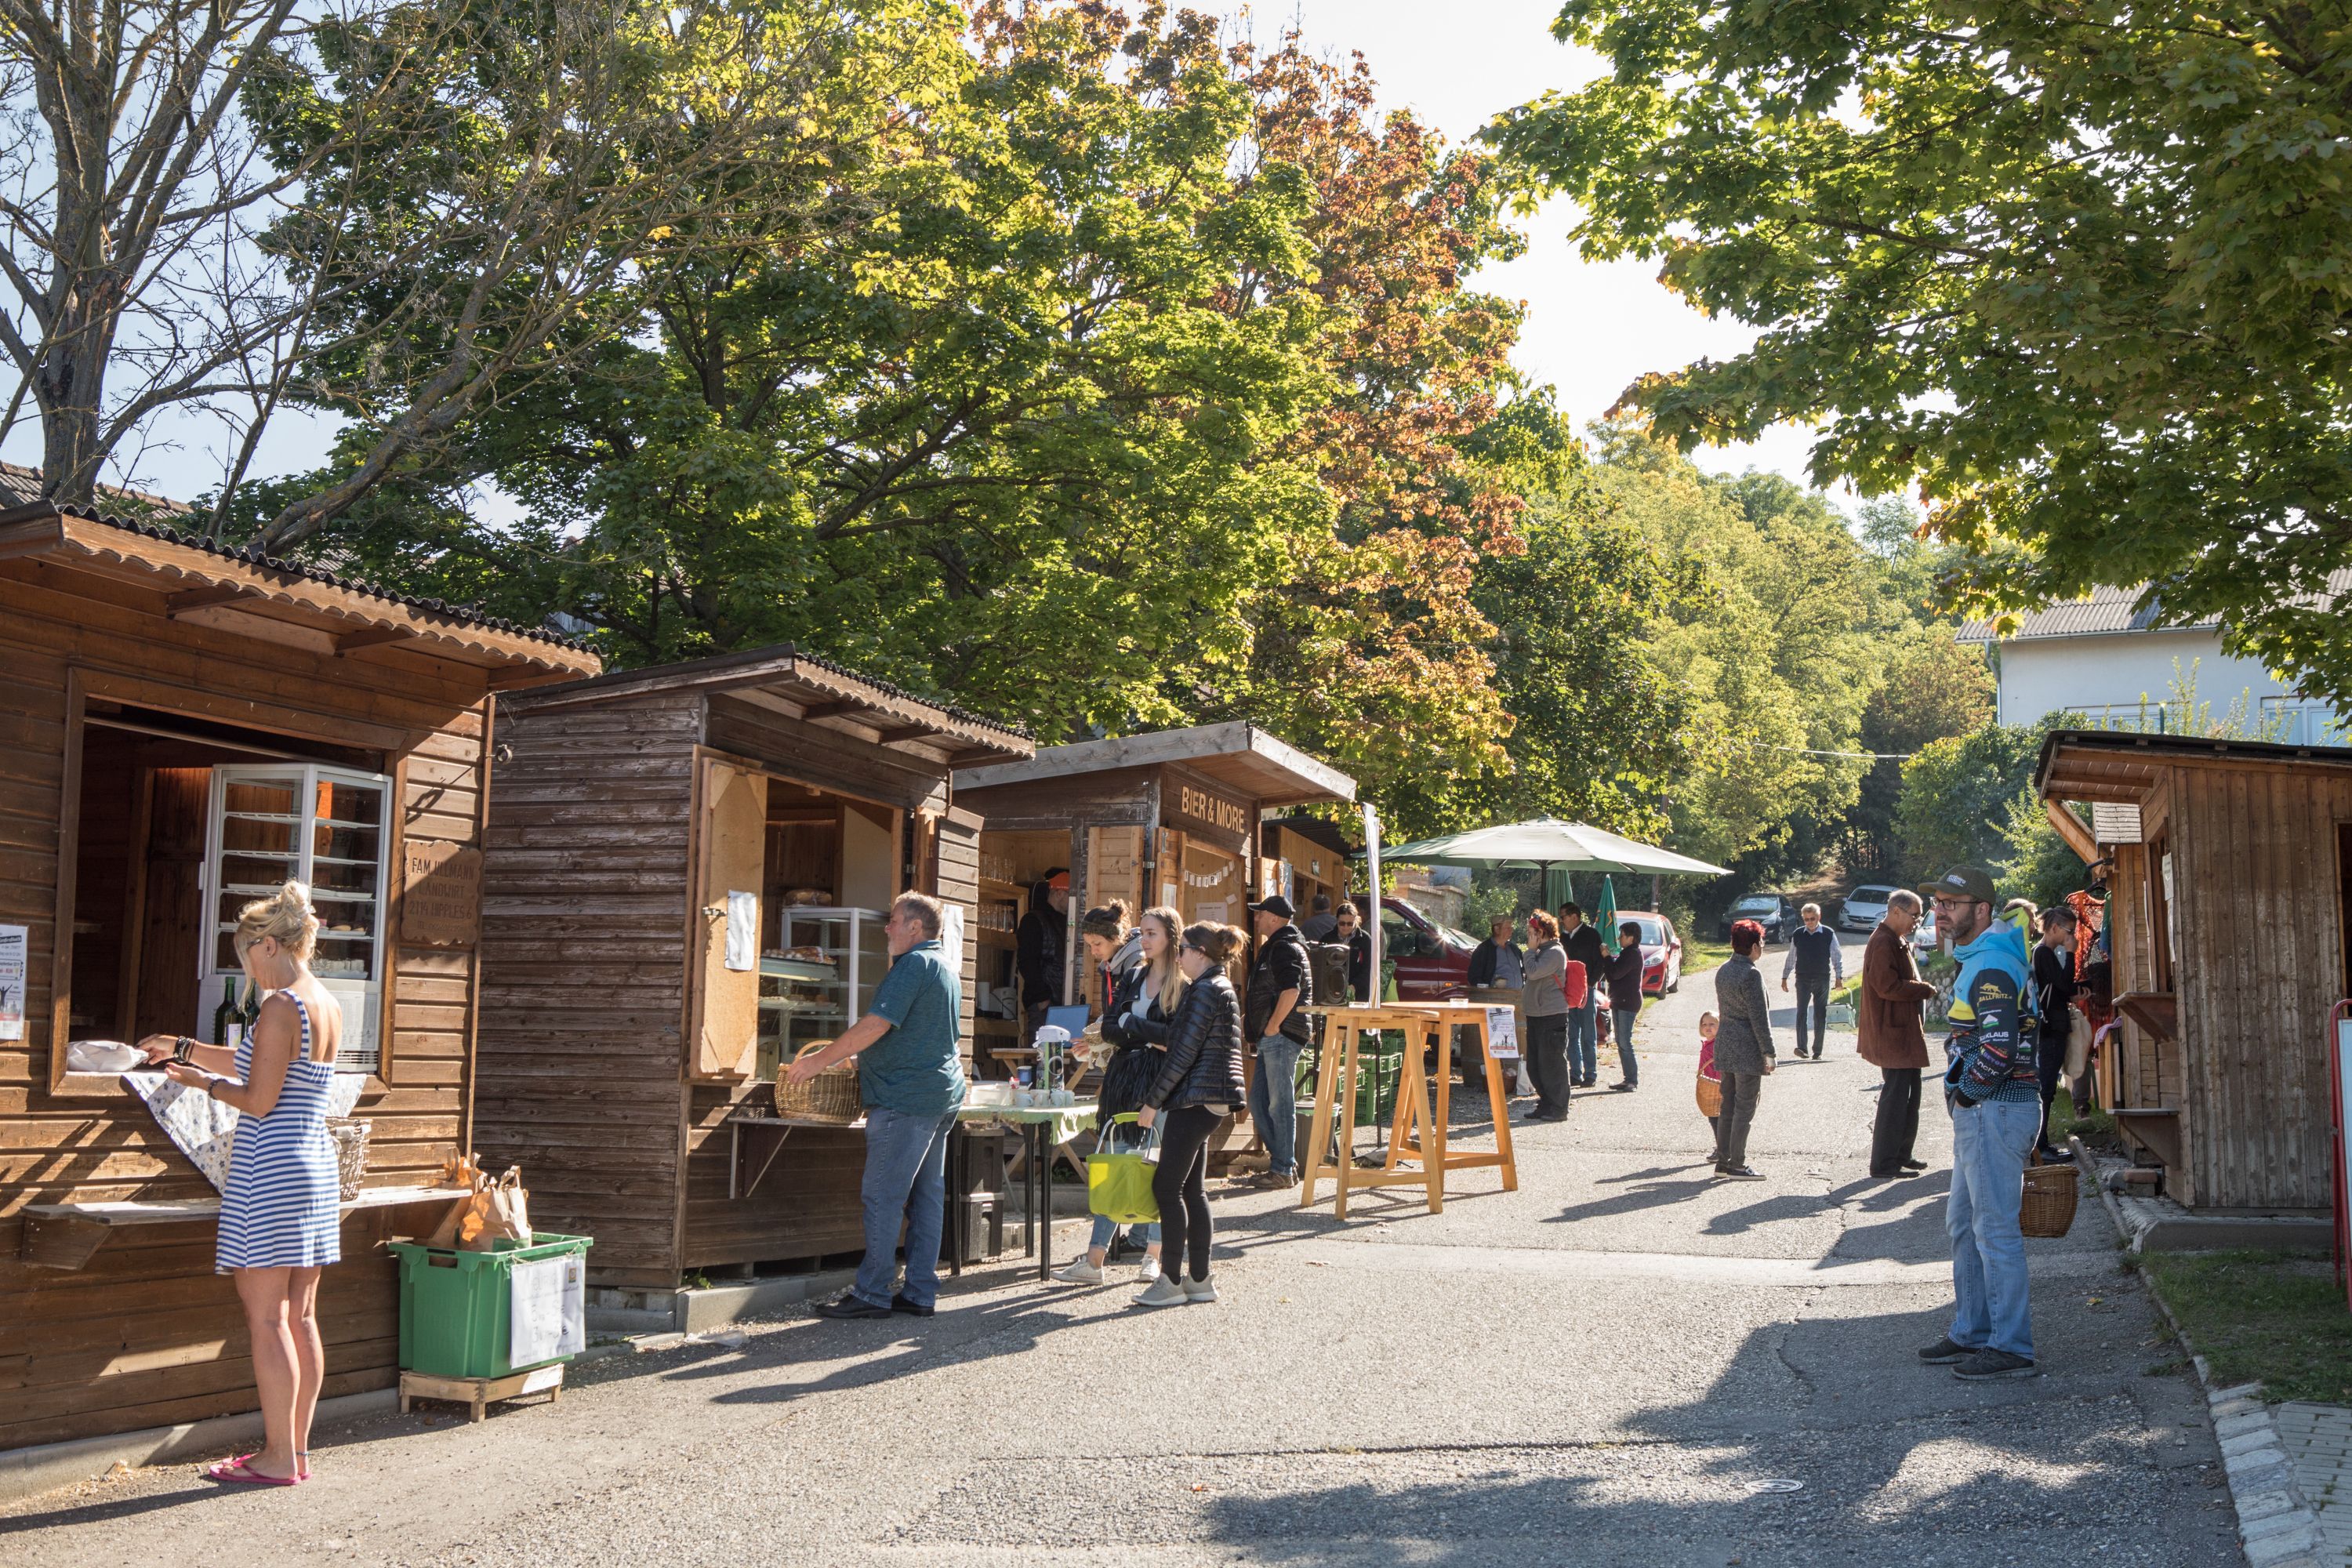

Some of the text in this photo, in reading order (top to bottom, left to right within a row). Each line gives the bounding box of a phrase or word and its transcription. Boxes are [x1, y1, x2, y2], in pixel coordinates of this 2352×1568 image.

[1181, 786, 1245, 834] BIER & MORE
[434, 859, 474, 880] ULLMANN
[418, 881, 465, 899] LANDWIRT
[408, 900, 428, 916] 2114
[431, 902, 465, 920] HIPPLES
